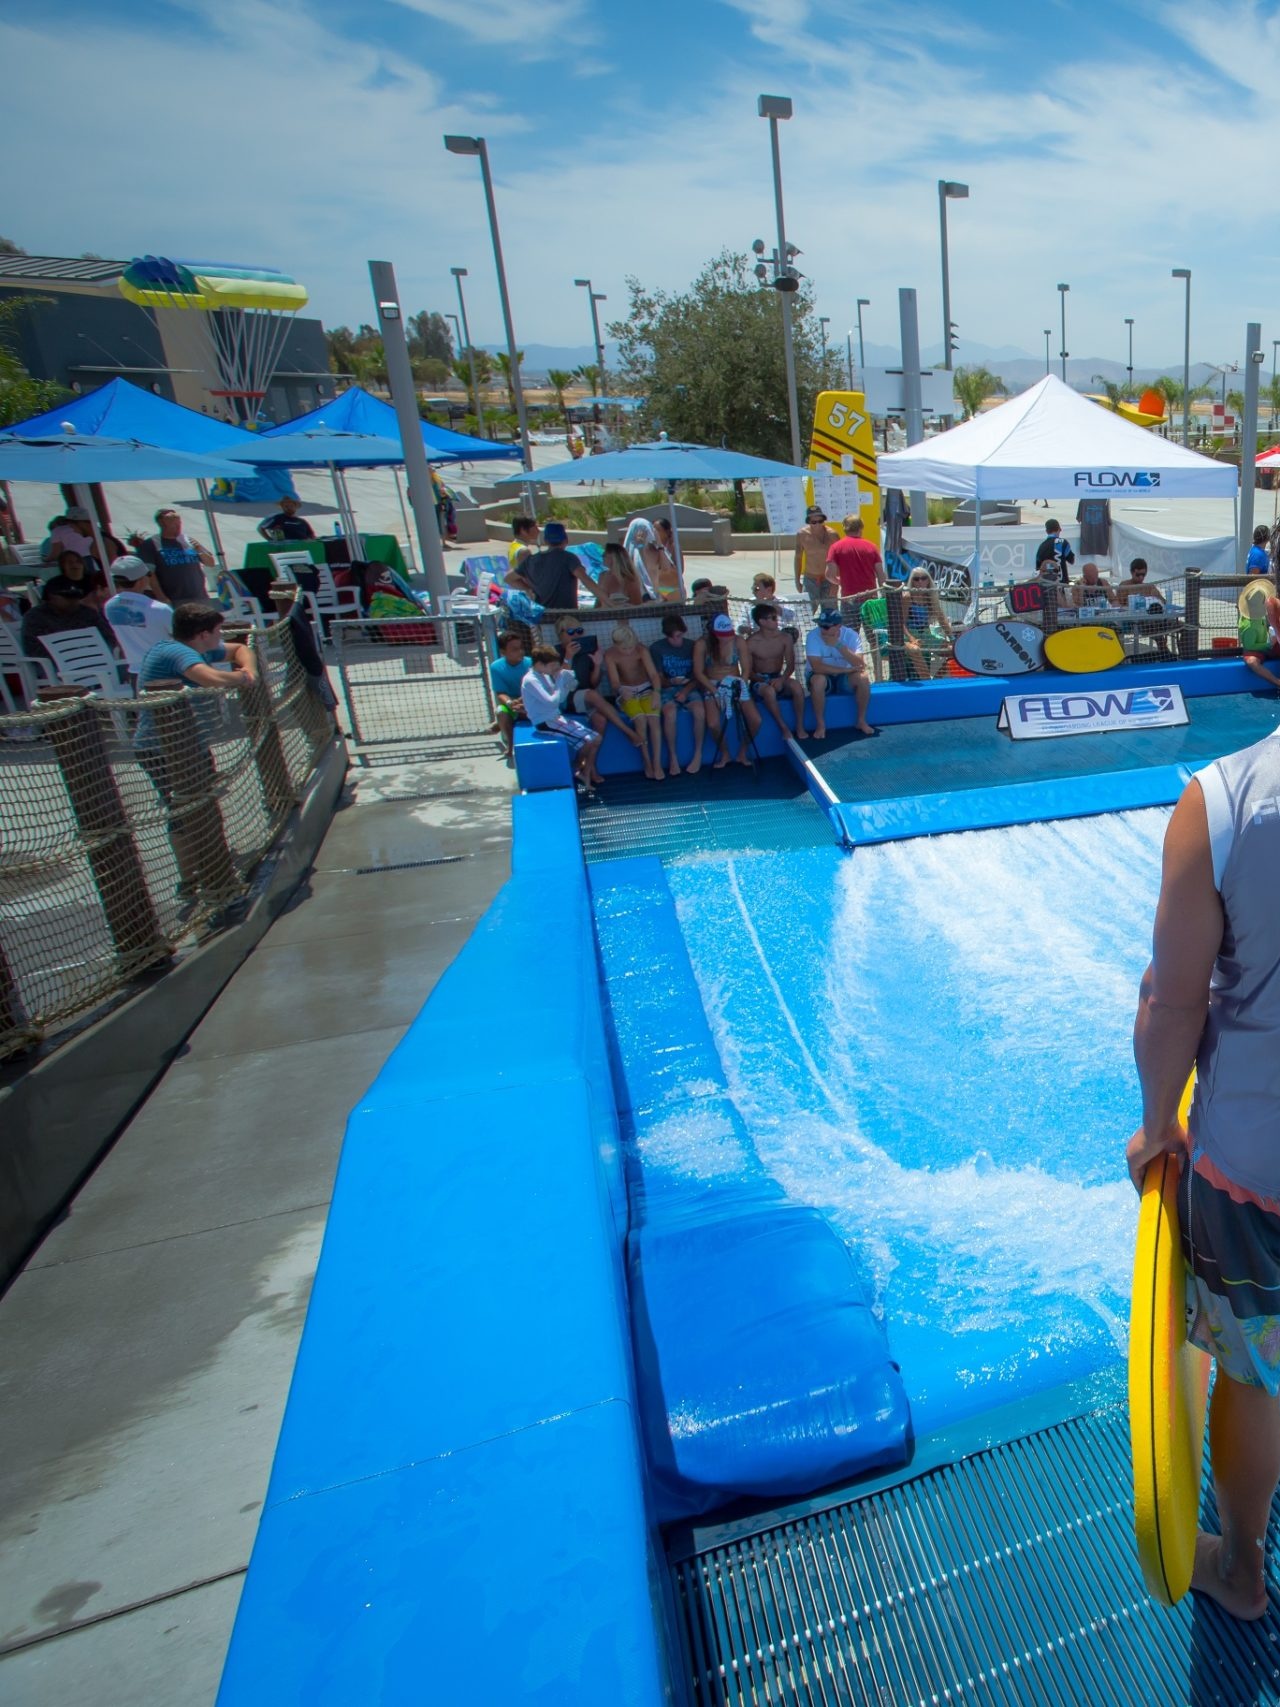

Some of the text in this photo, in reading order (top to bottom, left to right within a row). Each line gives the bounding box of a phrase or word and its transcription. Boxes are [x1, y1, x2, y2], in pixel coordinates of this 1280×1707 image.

[828, 402, 865, 436] 57
[1074, 472, 1135, 487] FLOW
[996, 623, 1036, 669] CARBON
[1018, 692, 1134, 722] FLOW
